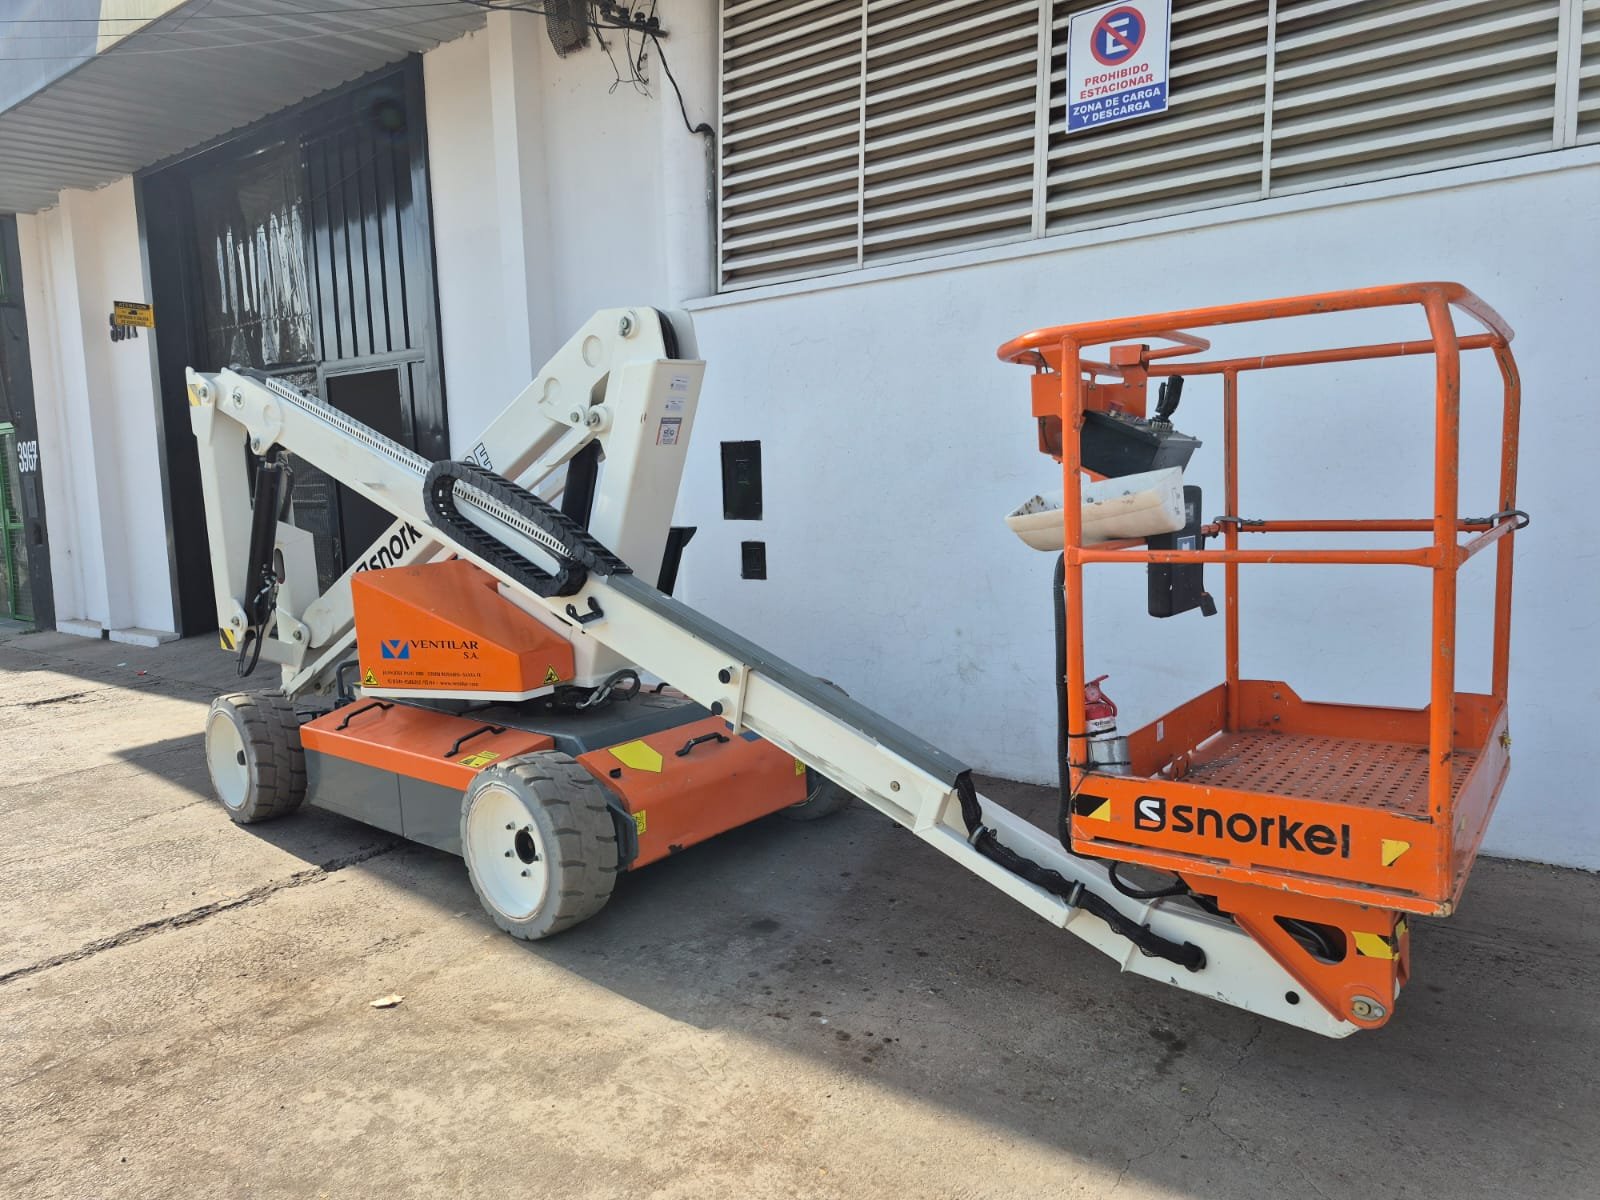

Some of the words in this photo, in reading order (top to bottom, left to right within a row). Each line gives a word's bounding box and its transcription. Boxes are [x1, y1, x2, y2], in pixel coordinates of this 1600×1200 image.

[1080, 73, 1154, 99] ESTACIONAR
[1084, 63, 1149, 87] PROHIBIDO
[1073, 101, 1102, 116] ZONA
[1105, 97, 1119, 108] DE
[1122, 87, 1161, 103] CARGA
[1082, 115, 1090, 124] Y
[1092, 101, 1151, 121] DESCARGA
[369, 520, 423, 571] snork
[410, 639, 479, 650] VENTILAR
[1172, 803, 1350, 859] snorkel
